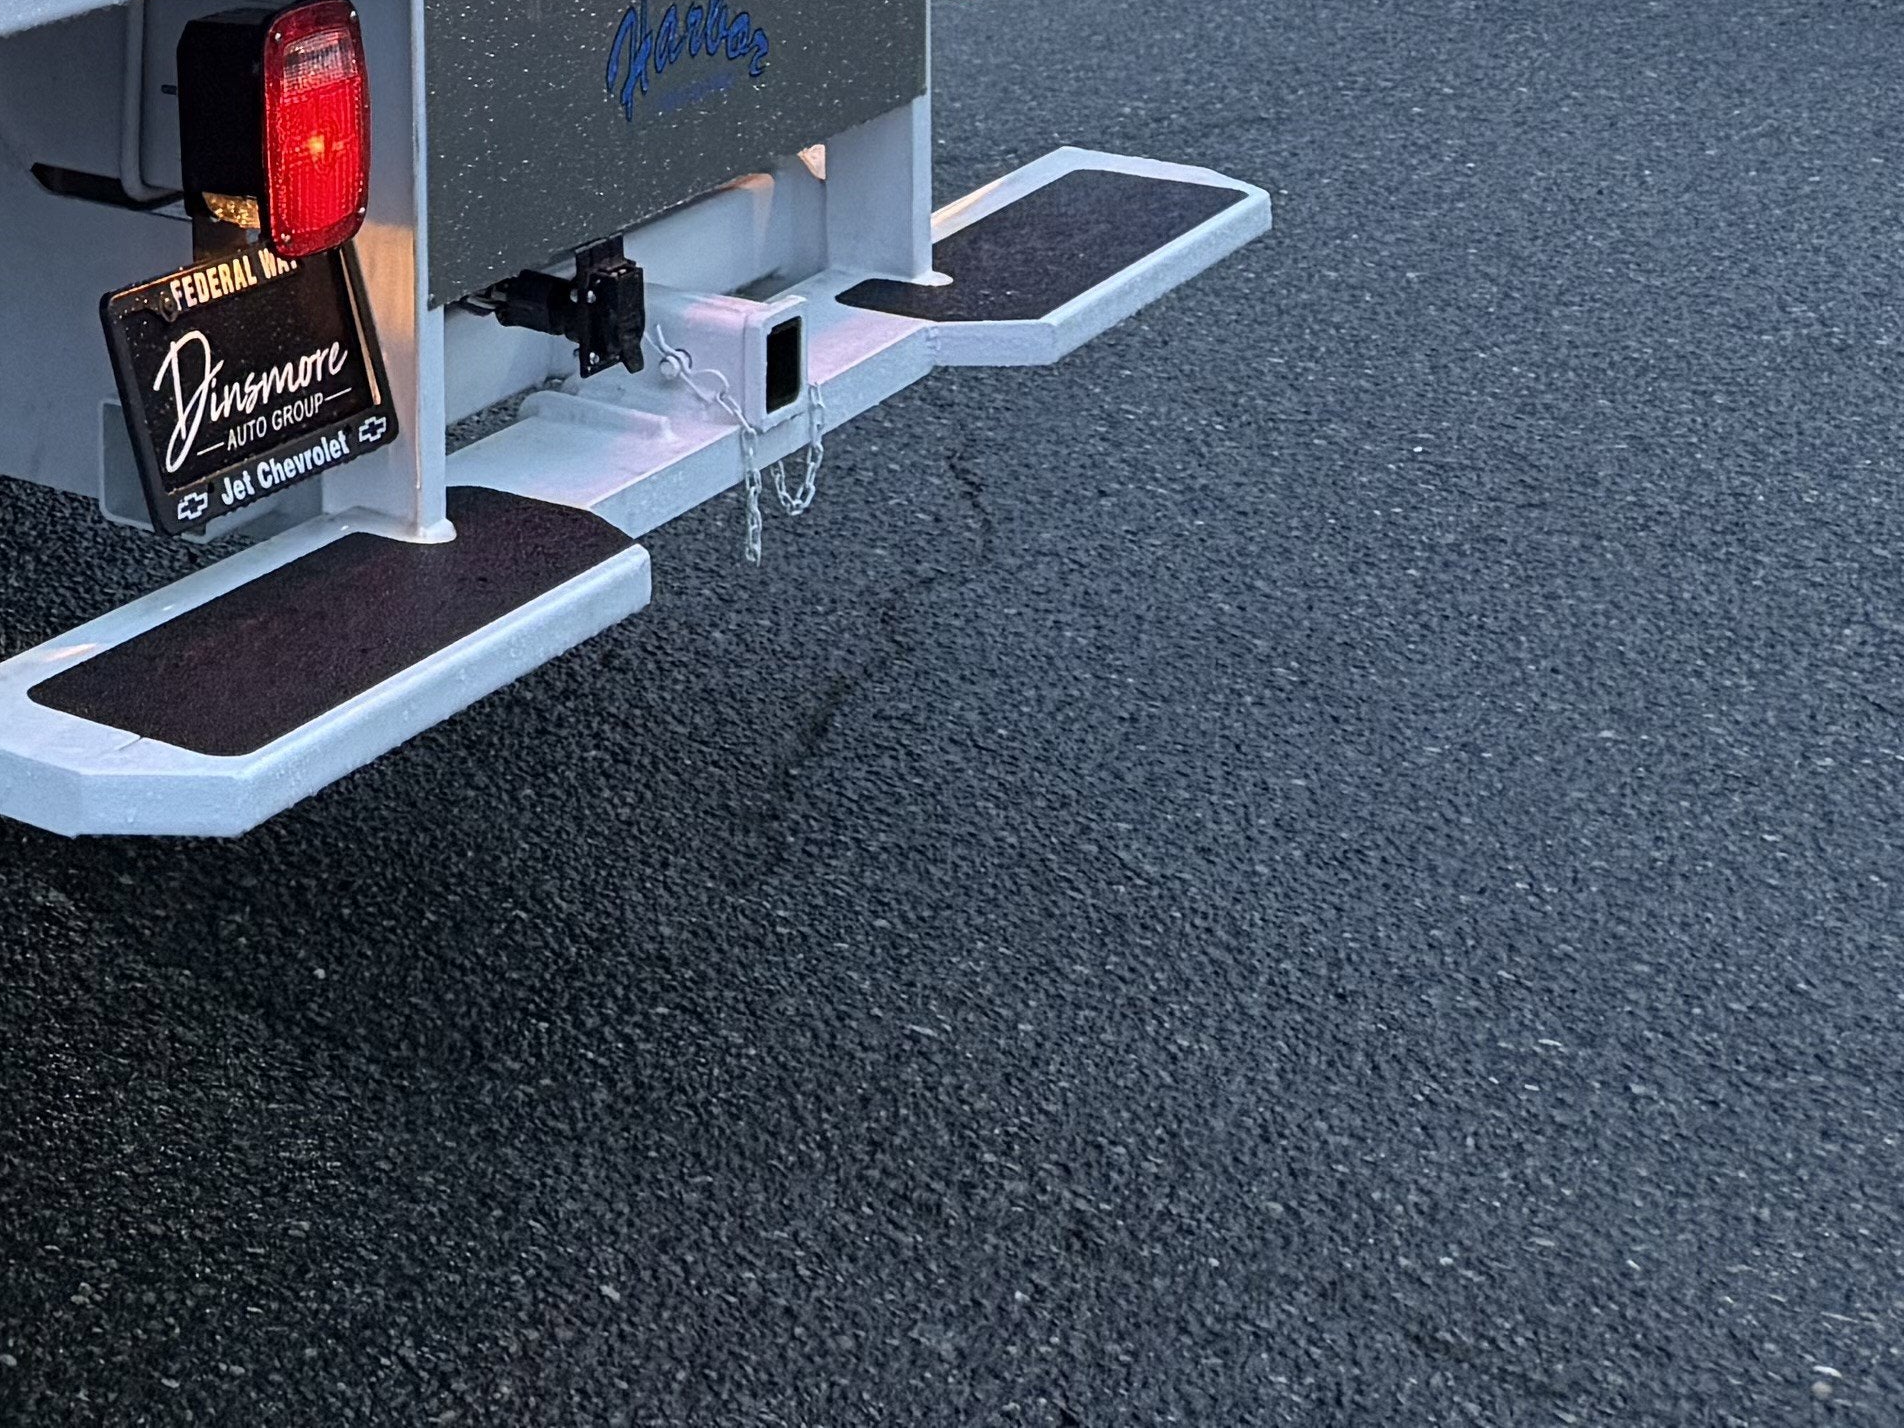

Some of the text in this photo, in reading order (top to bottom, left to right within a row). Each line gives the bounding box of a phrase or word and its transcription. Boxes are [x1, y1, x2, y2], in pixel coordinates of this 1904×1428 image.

[170, 255, 258, 311] FEDERAL
[153, 330, 348, 473] Dinsmore
[227, 392, 324, 452] AUTO GROUP
[221, 430, 350, 506] Jet Chevrolet
